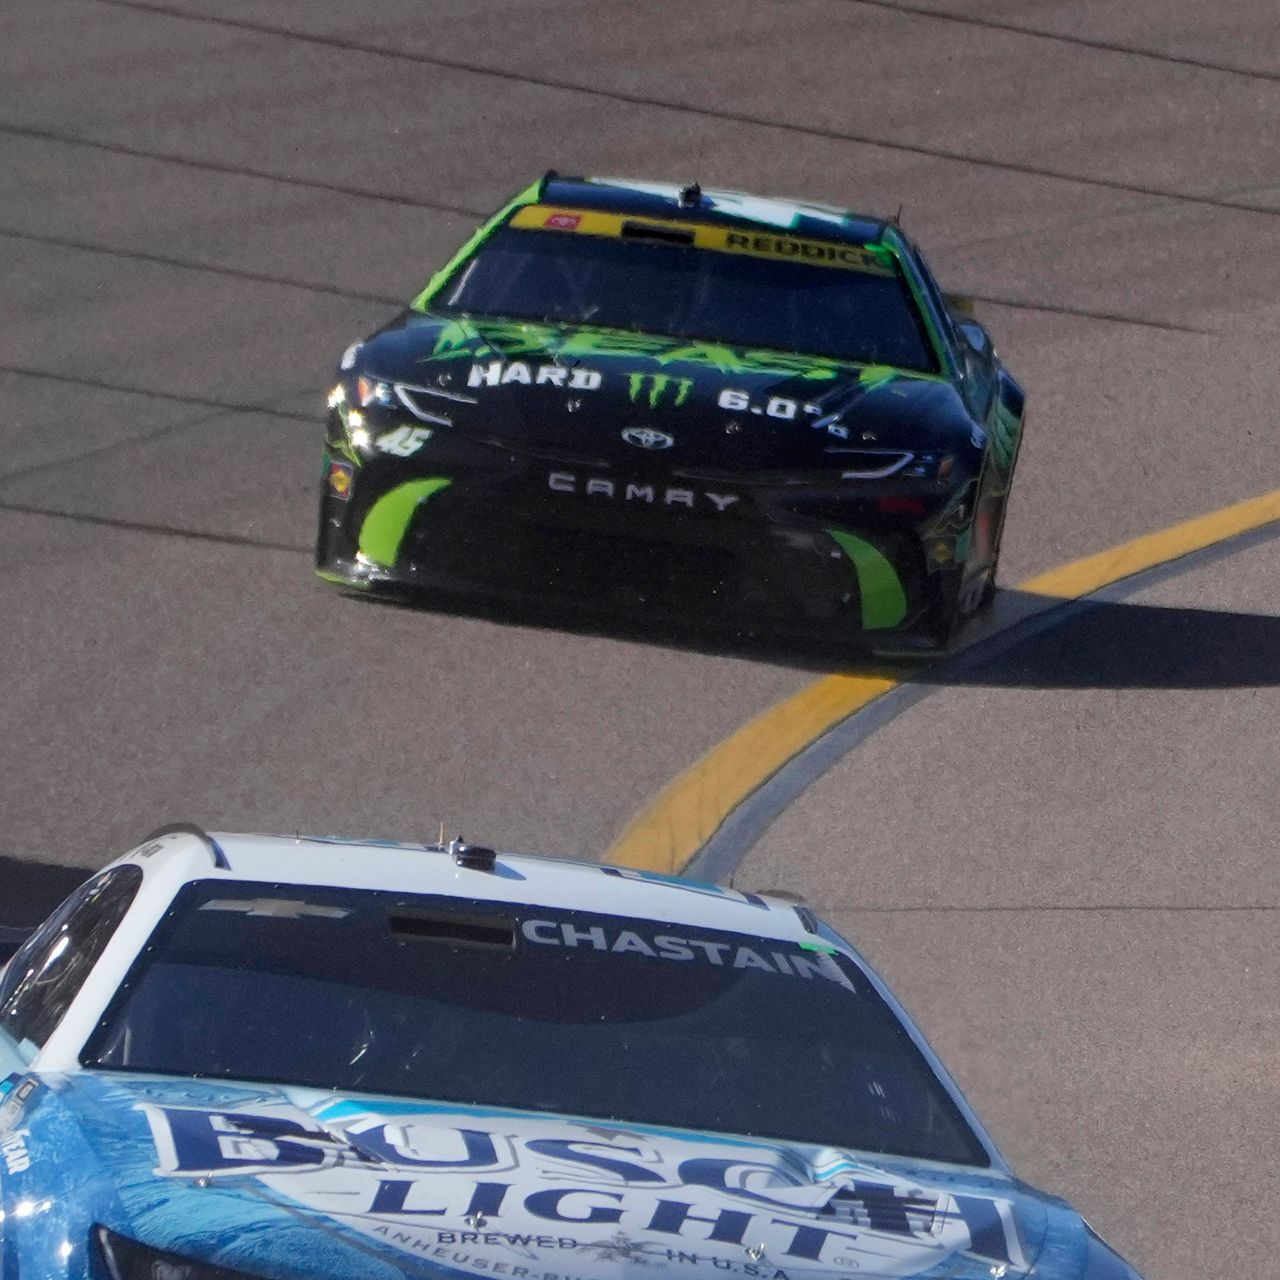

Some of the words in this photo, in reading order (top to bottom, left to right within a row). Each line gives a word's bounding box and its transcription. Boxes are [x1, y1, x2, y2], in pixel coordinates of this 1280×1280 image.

[725, 231, 880, 267] REDDICK
[467, 361, 602, 390] HARD
[376, 426, 434, 458] 45
[548, 472, 740, 510] CAMRY
[520, 918, 847, 987] CHASTAIN
[152, 1103, 1025, 1269] BUSCH
[368, 1179, 858, 1262] LIGHT
[436, 1231, 579, 1250] BREWED
[666, 1248, 698, 1265] IN
